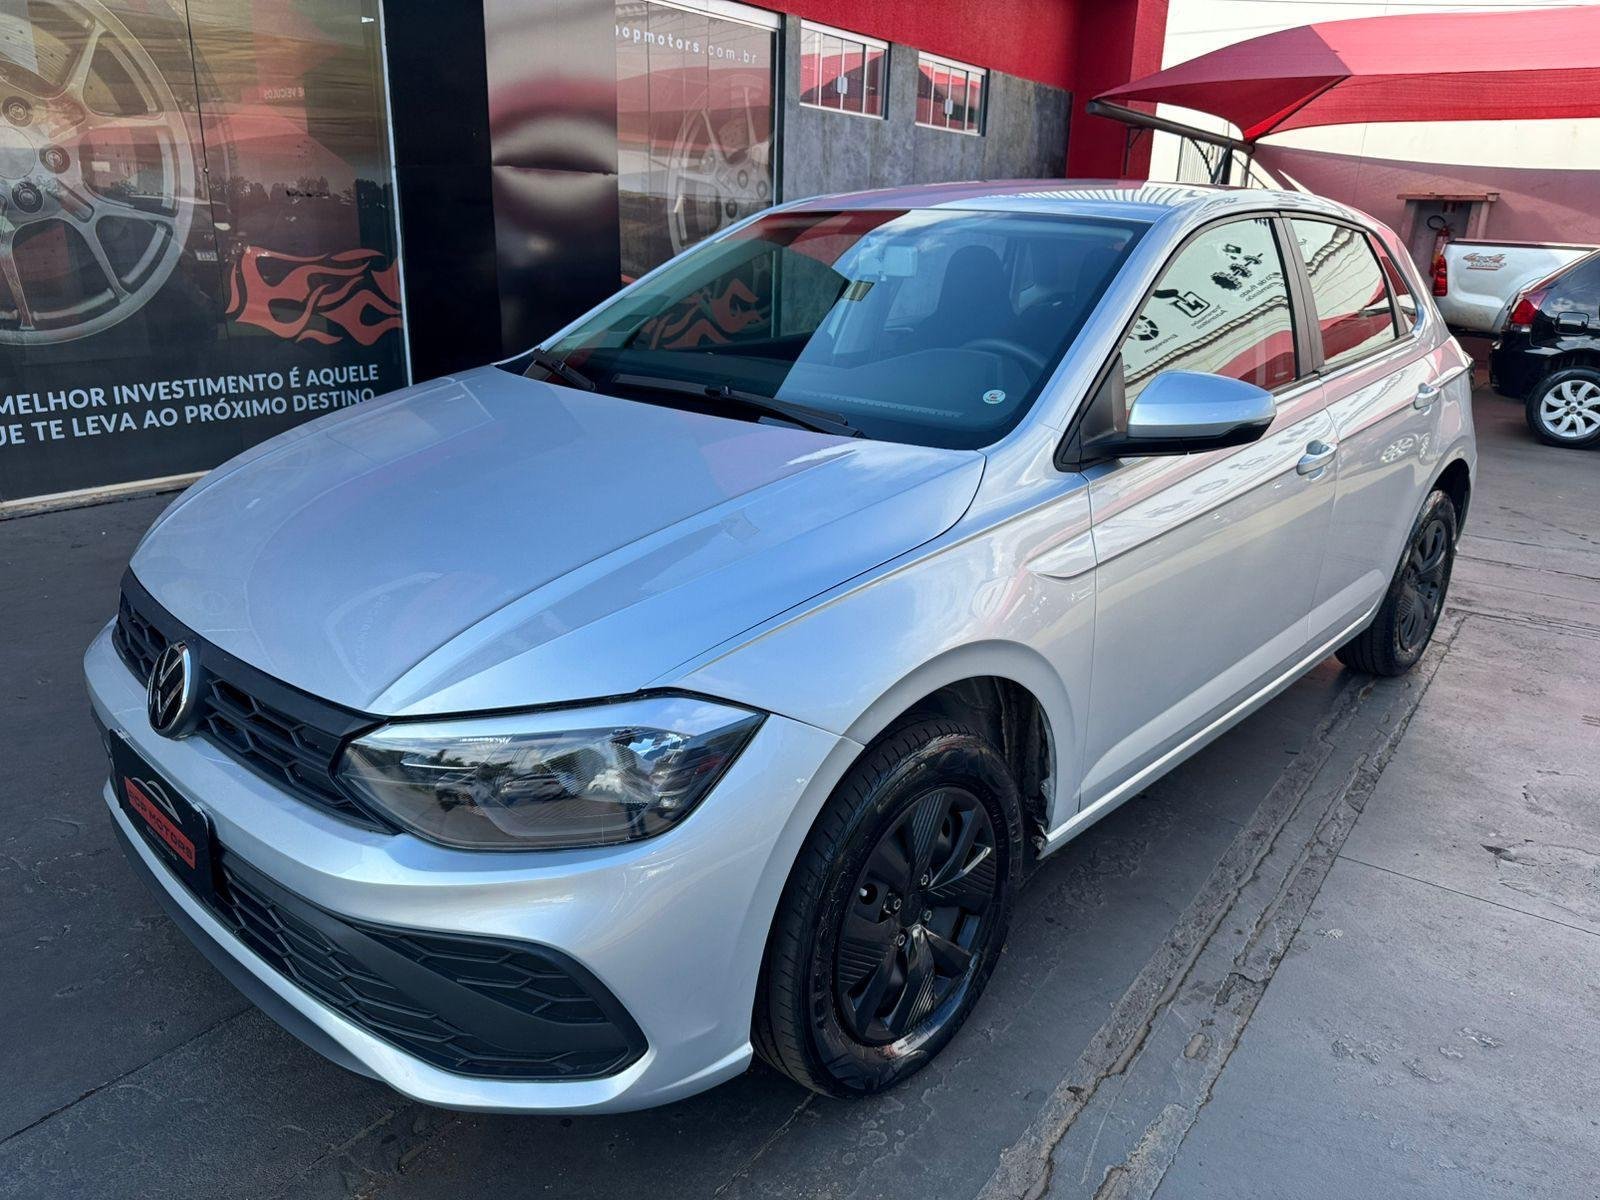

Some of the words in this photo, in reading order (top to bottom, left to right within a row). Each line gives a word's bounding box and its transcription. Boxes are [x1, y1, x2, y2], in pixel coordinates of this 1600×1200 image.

[0, 387, 107, 415] MELHOR
[113, 370, 282, 405] INVESTIMENTO
[289, 366, 301, 388] É
[305, 363, 379, 387] AQUELE
[31, 418, 65, 442] TE
[72, 411, 137, 438] LEVA
[143, 407, 178, 428] AO
[185, 396, 287, 424] PRÓXIMO
[293, 387, 375, 412] DESTINO
